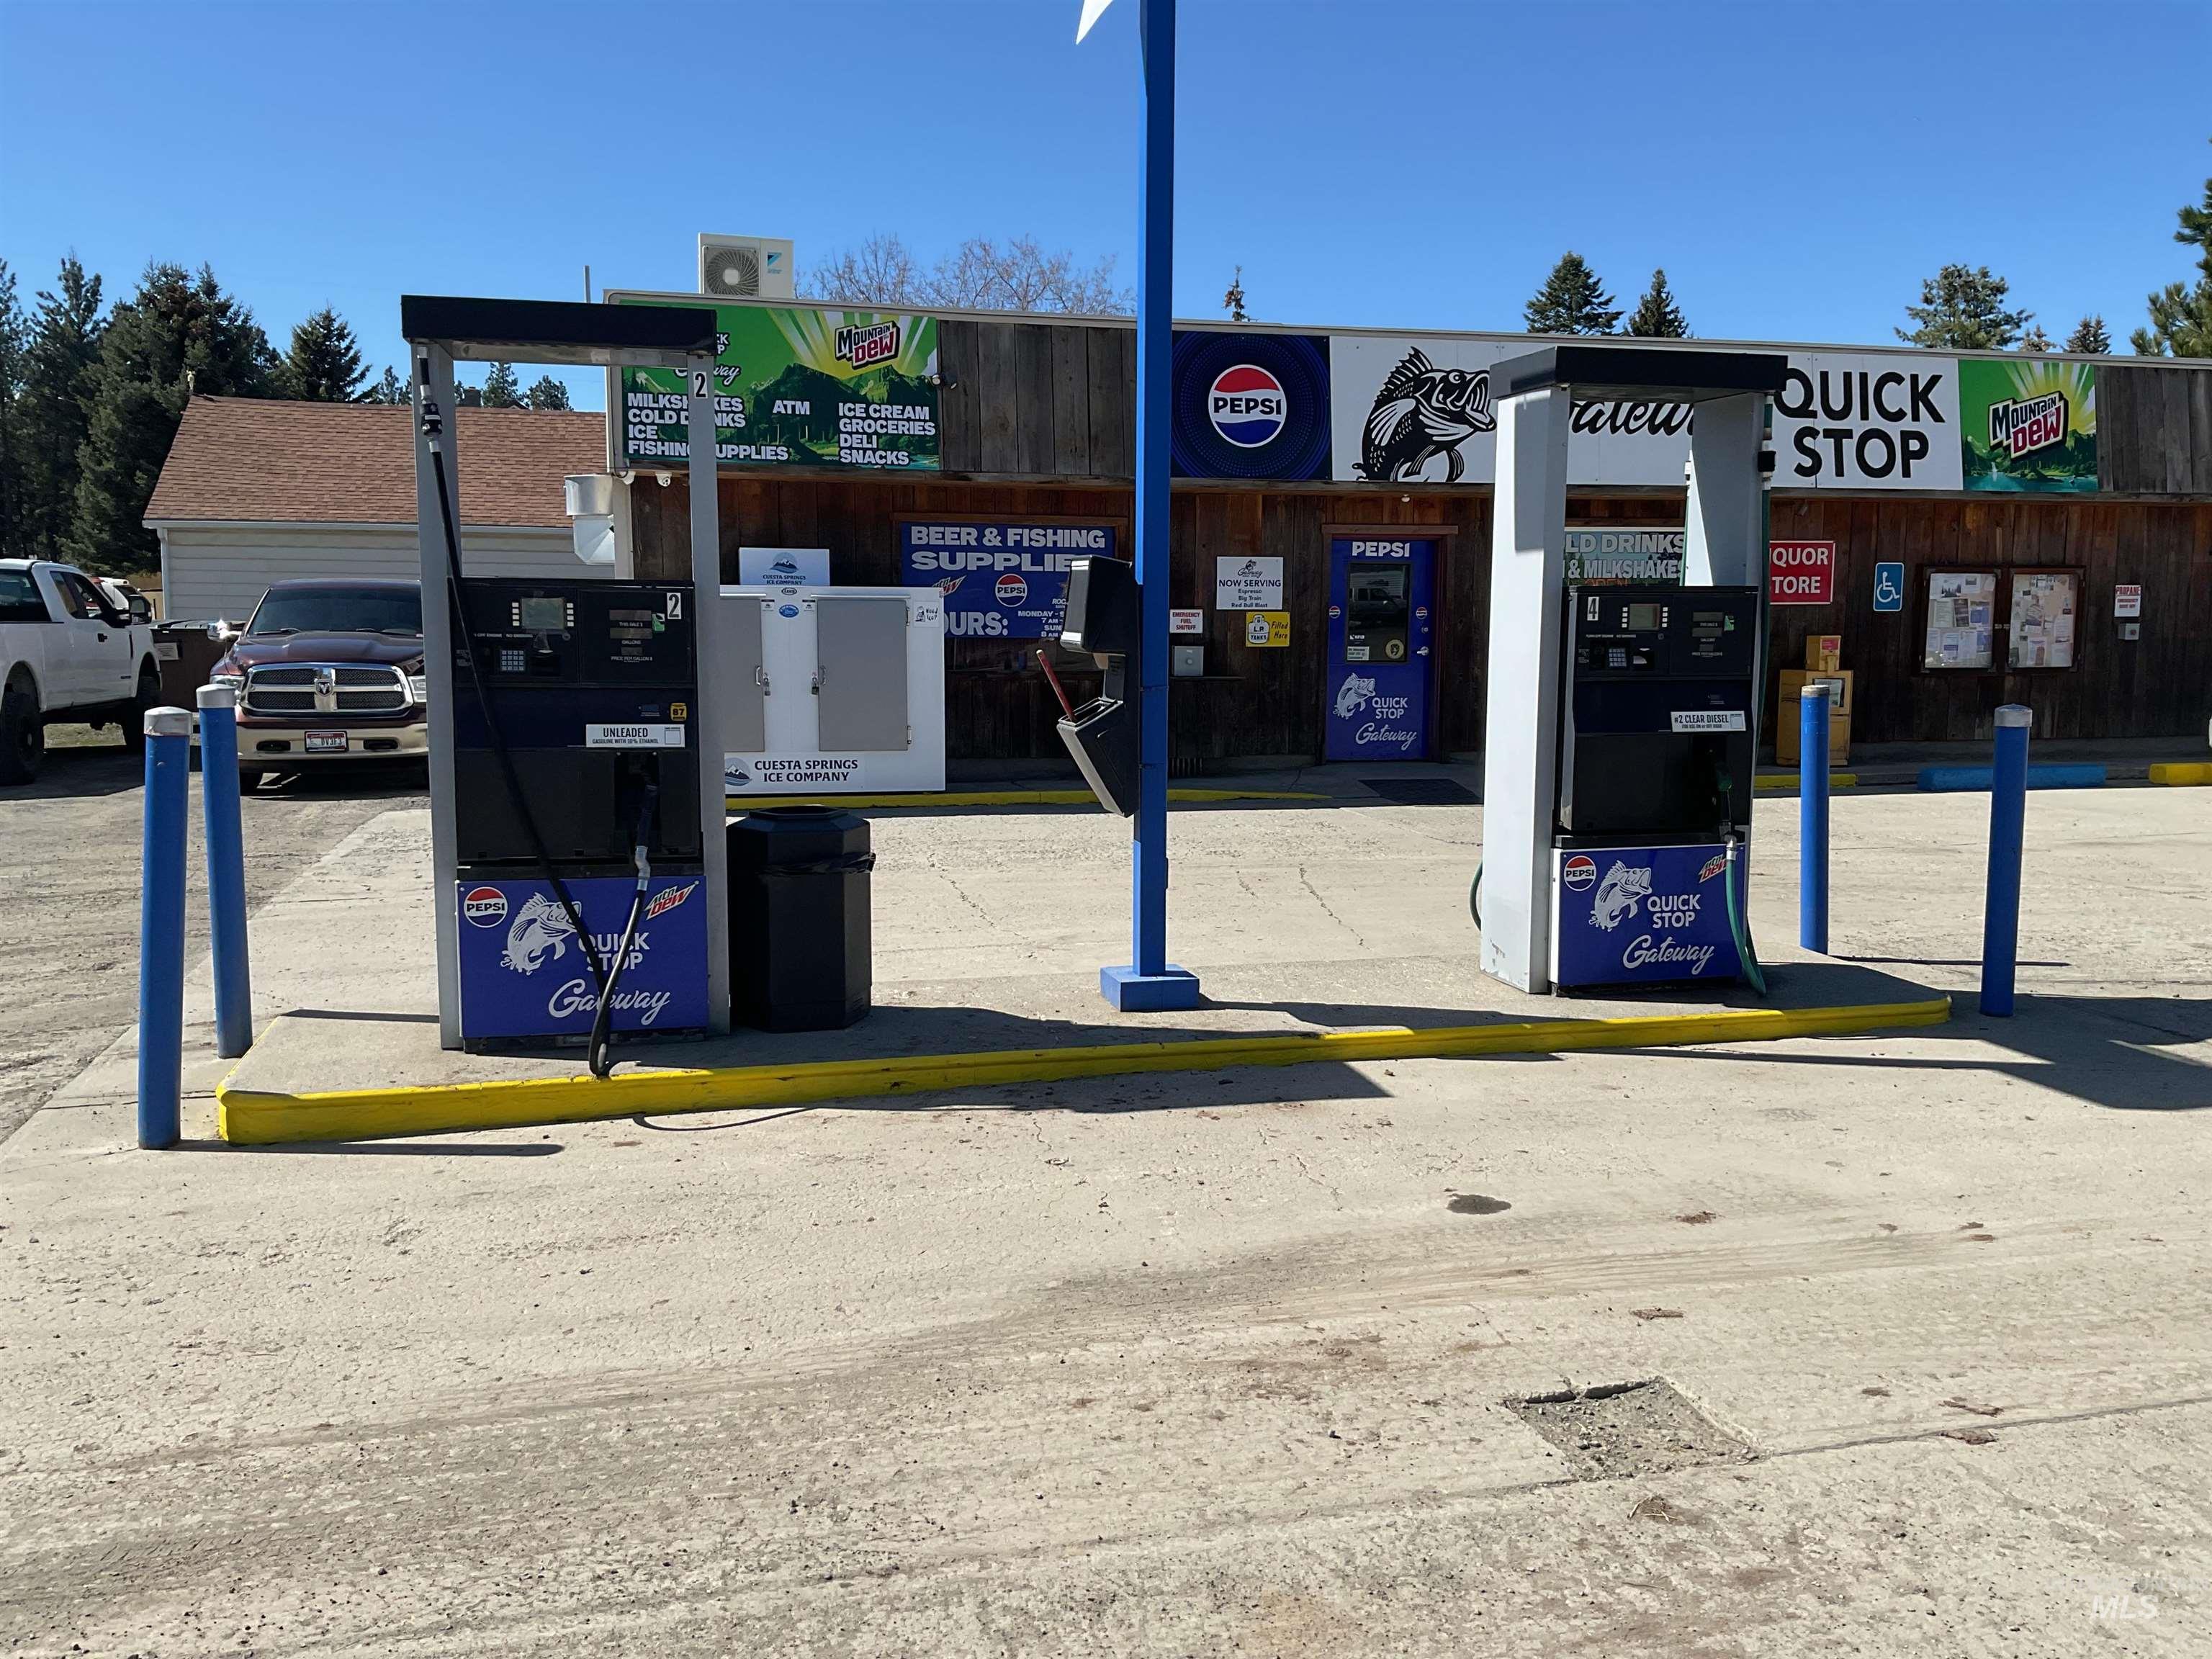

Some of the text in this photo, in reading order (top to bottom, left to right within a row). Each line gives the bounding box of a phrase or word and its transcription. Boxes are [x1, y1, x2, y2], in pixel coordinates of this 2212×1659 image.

[695, 373, 706, 397] 2
[1773, 367, 1946, 423] QUICK
[773, 400, 811, 415] ATM
[838, 403, 930, 421] ICE CREAM
[1213, 397, 1282, 415] PEPSI
[628, 409, 677, 425] COLD
[628, 425, 658, 439] ICE
[839, 418, 936, 436] GROCERIES
[840, 433, 878, 449] DELI
[629, 441, 788, 461] FISHIN UPPLIES
[840, 449, 910, 465] SNACKS
[1794, 426, 1930, 478] STOP
[911, 526, 1105, 549] BEER & FISHING
[1601, 534, 1683, 553] DRINKS
[1352, 541, 1411, 557] PEPSI
[911, 551, 1072, 572] SUPPLIE
[1568, 559, 1581, 578] &
[1218, 579, 1282, 588] NOW SERVING
[1771, 576, 1821, 594] TORE
[669, 594, 679, 618] 2
[1588, 598, 1597, 619] 4
[944, 611, 1008, 637] URS:
[1271, 621, 1289, 629] Filled
[1274, 631, 1288, 639] Here
[1372, 697, 1408, 709] QUICK
[1375, 709, 1405, 719] STOP
[1674, 714, 1729, 724] #2 CLEAR DIESEL
[603, 727, 648, 738] UNLEADED
[1355, 722, 1417, 751] Gateway
[755, 760, 858, 770] CUESTA SPRINGS
[764, 772, 850, 782] ICE COMPANY
[1565, 869, 1594, 878] PEPSI
[467, 902, 505, 912] PEPSI
[1647, 894, 1701, 911] QUICK
[1653, 912, 1696, 929] STOP
[1623, 935, 1715, 975] Gateway
